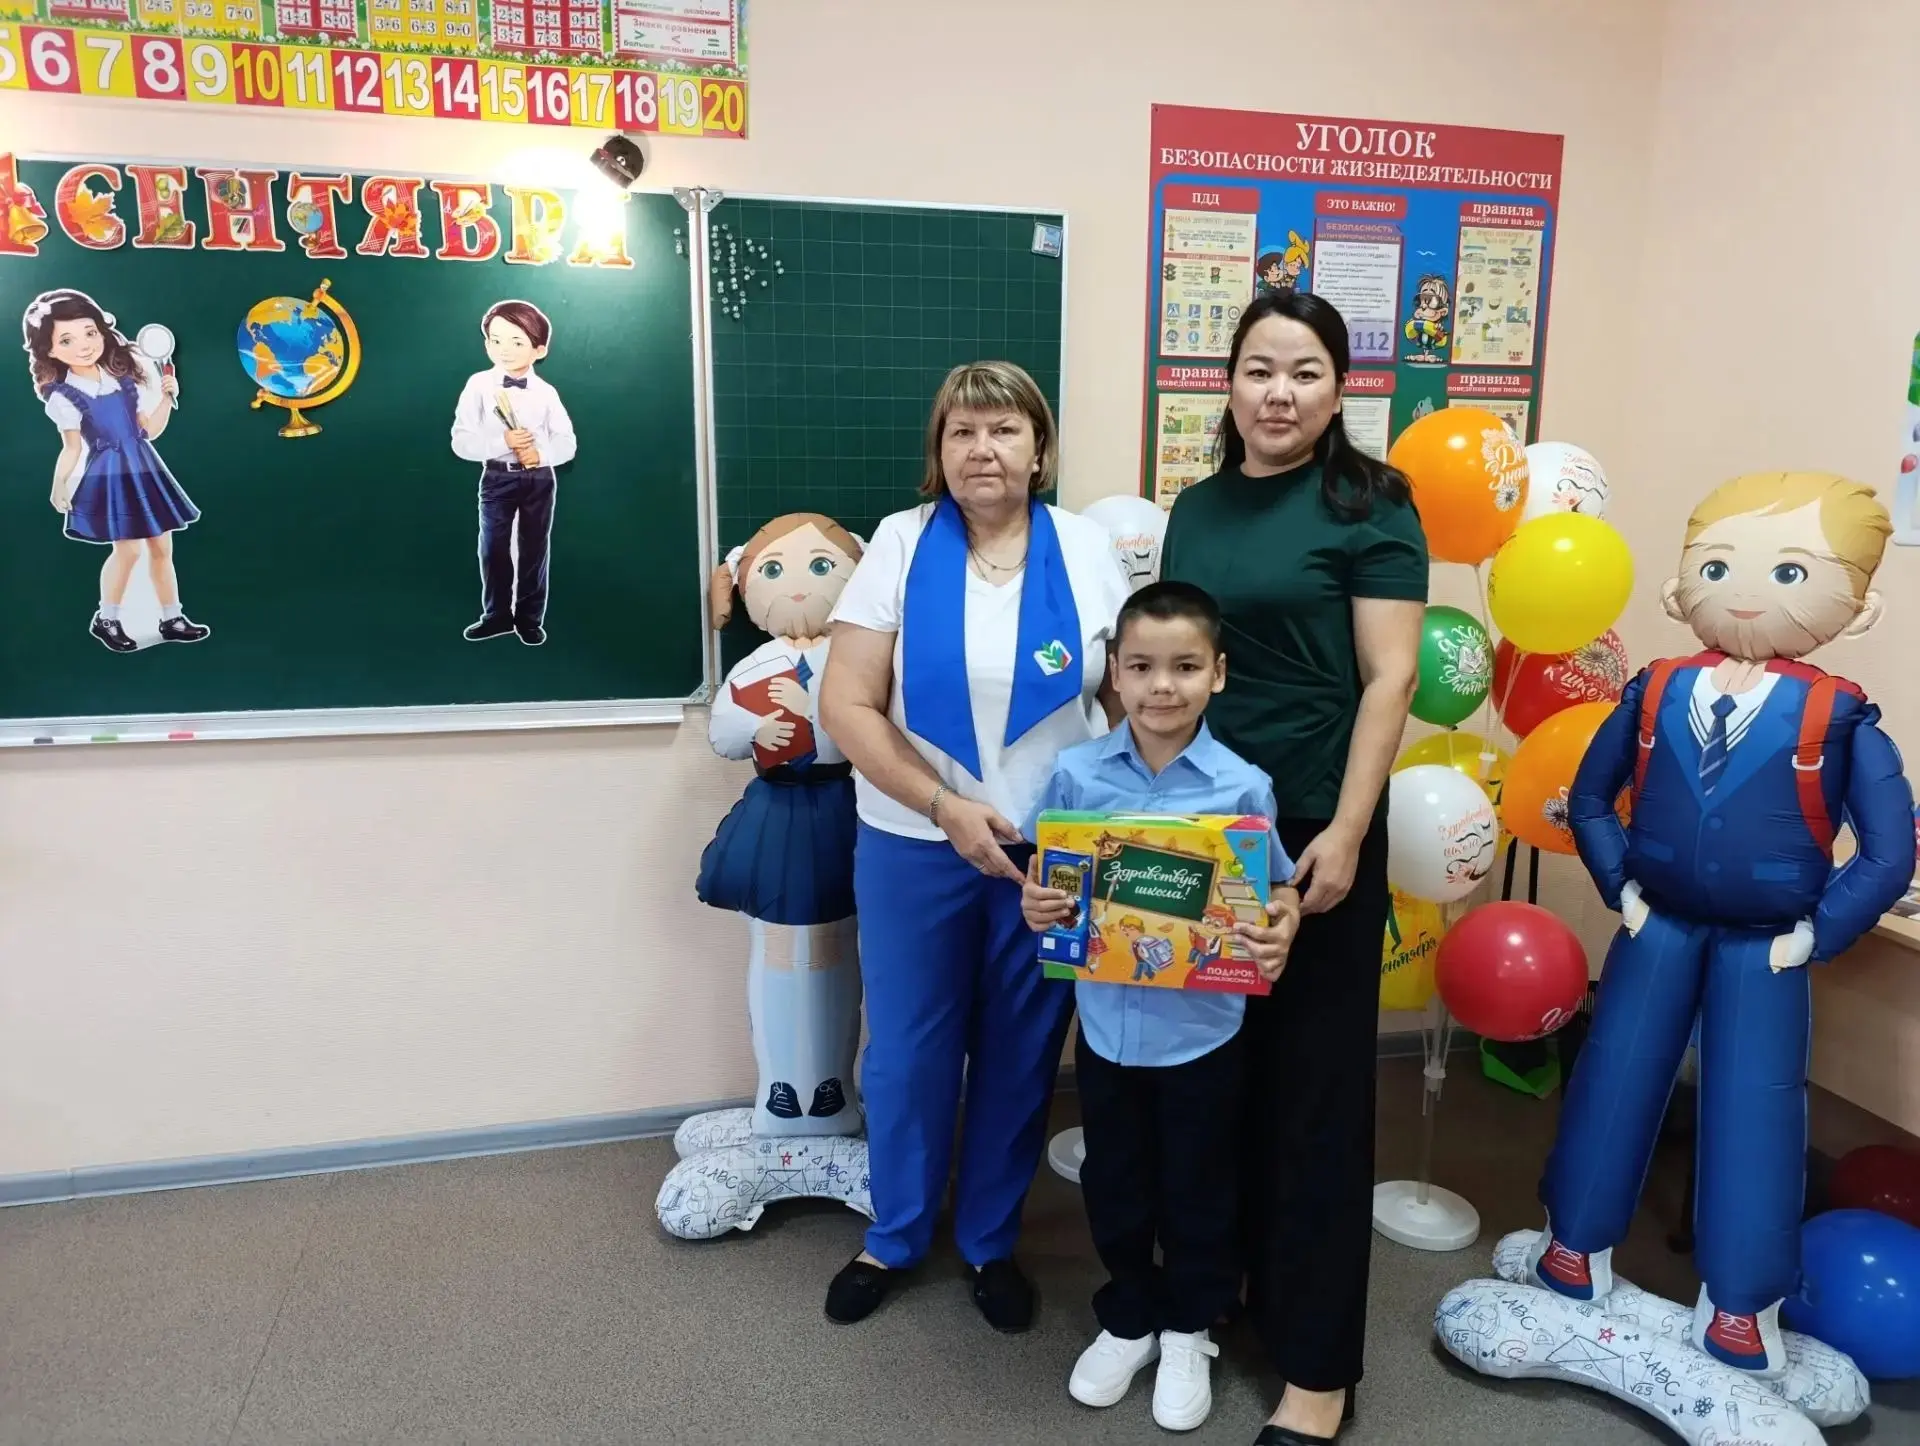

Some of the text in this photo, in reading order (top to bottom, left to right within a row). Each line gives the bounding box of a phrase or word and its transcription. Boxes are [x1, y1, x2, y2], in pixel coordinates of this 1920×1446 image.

[633, 18, 717, 35] Знаки сравнения
[30, 31, 71, 86] 6
[85, 36, 124, 90] 7
[142, 40, 181, 94] 8
[191, 44, 229, 96] 9
[234, 48, 280, 101] 10
[287, 51, 326, 103] 11
[335, 55, 381, 106] 12
[384, 58, 431, 111] 13
[434, 62, 479, 113] 14
[481, 65, 525, 117] 15
[527, 70, 570, 120] 16
[571, 73, 613, 122] 17
[616, 74, 657, 125] 18
[660, 77, 700, 128] 19
[702, 83, 745, 132] 20
[1295, 122, 1437, 159] УГОЛОК
[1160, 148, 1553, 190] БЕЗОПАСНОСТИ ЖИЗНЕДЕЯТЕЛЬНОСТИ
[1191, 191, 1221, 207] ПДД
[1326, 199, 1396, 213] ЭТО ВАЖНО!
[1473, 203, 1534, 217] правила
[1460, 215, 1545, 228] поведения на воде
[1353, 331, 1389, 351] 112
[1156, 380, 1207, 388] поведения
[1209, 380, 1221, 388] на
[1460, 374, 1520, 387] правила
[1447, 386, 1532, 396] поведения при пожаре
[1051, 869, 1080, 883] Alpen
[1103, 861, 1203, 888] Здравствуй,
[1052, 879, 1078, 893] Gold
[1134, 885, 1191, 900] школа!
[1381, 930, 1438, 976] ентября
[1207, 967, 1255, 979] ПОДАРОК
